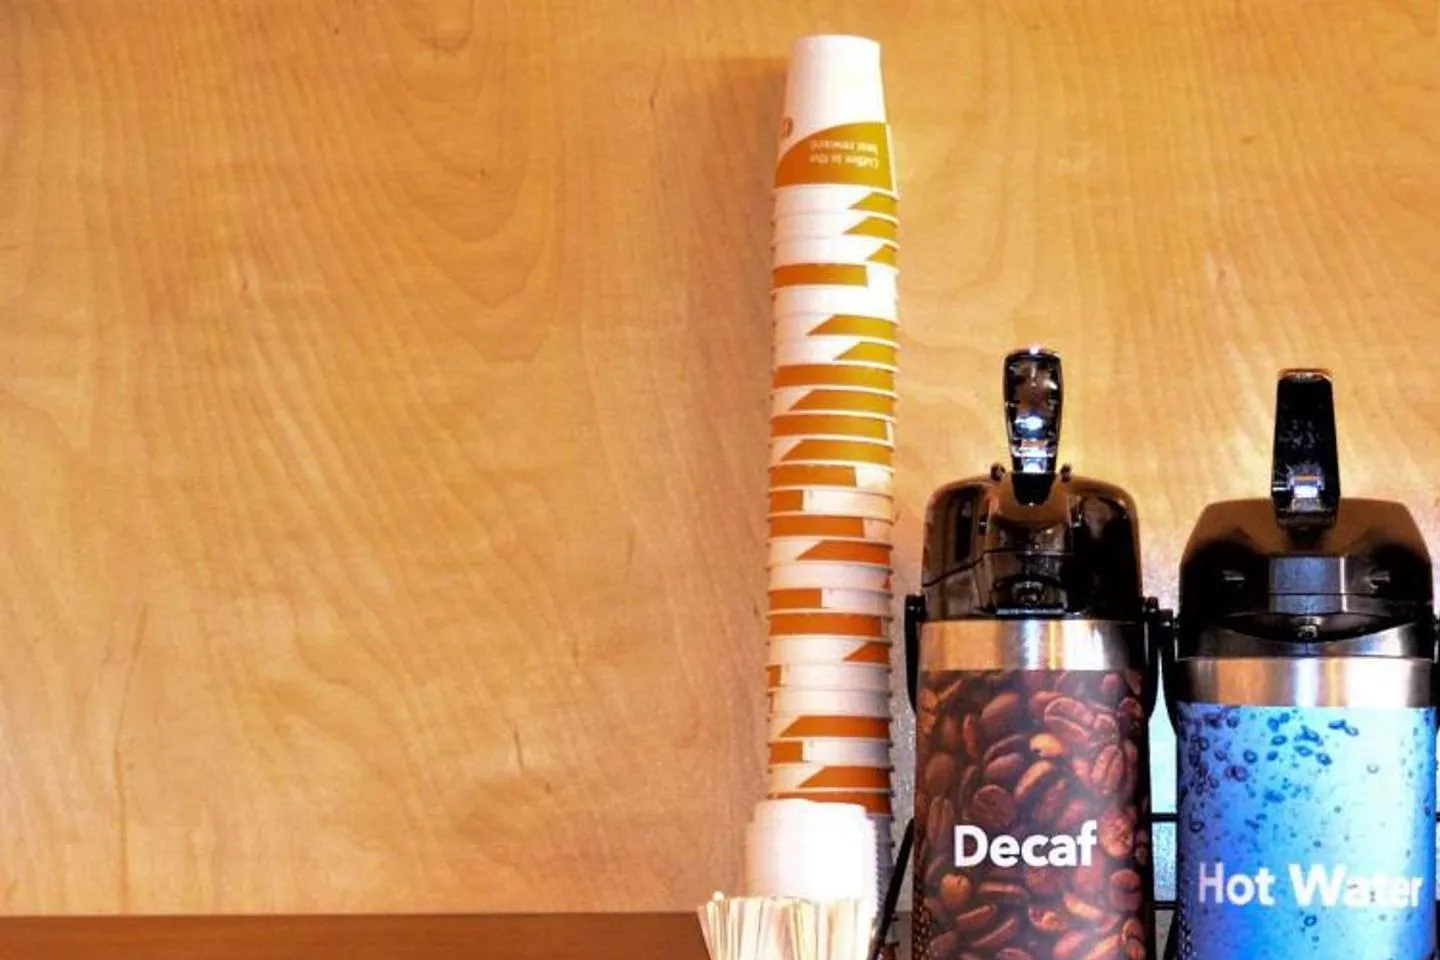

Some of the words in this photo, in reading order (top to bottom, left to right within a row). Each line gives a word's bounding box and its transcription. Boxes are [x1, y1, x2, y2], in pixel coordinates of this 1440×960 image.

[954, 819, 1098, 868] Decaf
[1199, 861, 1277, 907] Hot
[1288, 862, 1424, 908] Water
